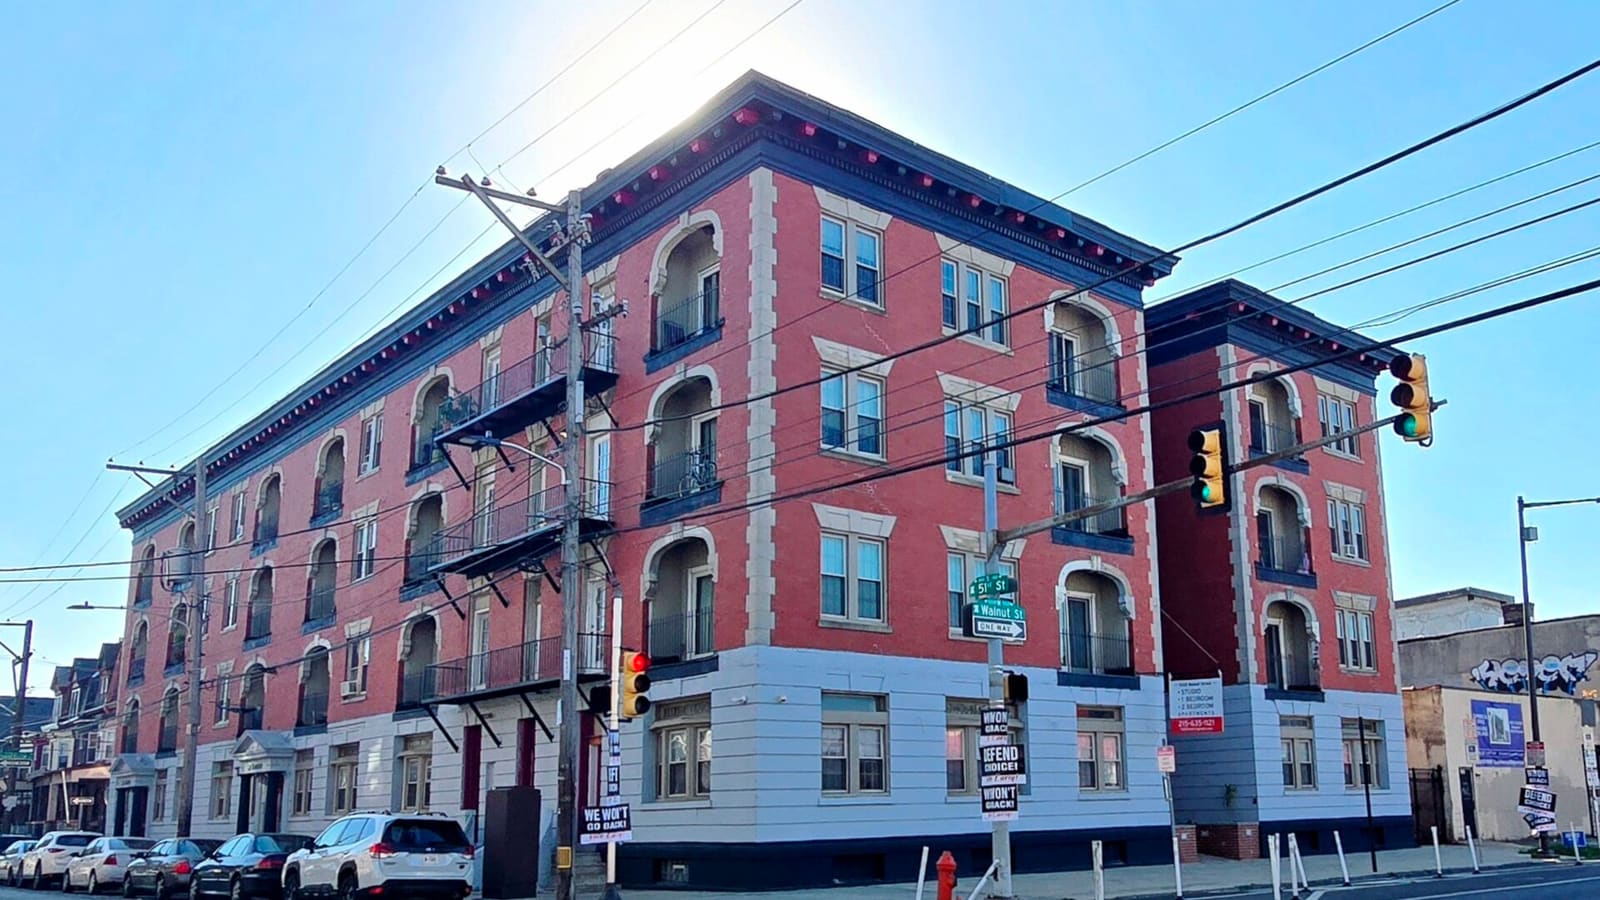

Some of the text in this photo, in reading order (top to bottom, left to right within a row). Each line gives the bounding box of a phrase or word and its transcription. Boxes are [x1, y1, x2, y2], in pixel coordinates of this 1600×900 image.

[995, 580, 1006, 591] St
[981, 604, 1023, 620] Walnut St
[980, 622, 1011, 632] ONE WAY
[584, 808, 601, 822] WE
[587, 822, 601, 831] GO
